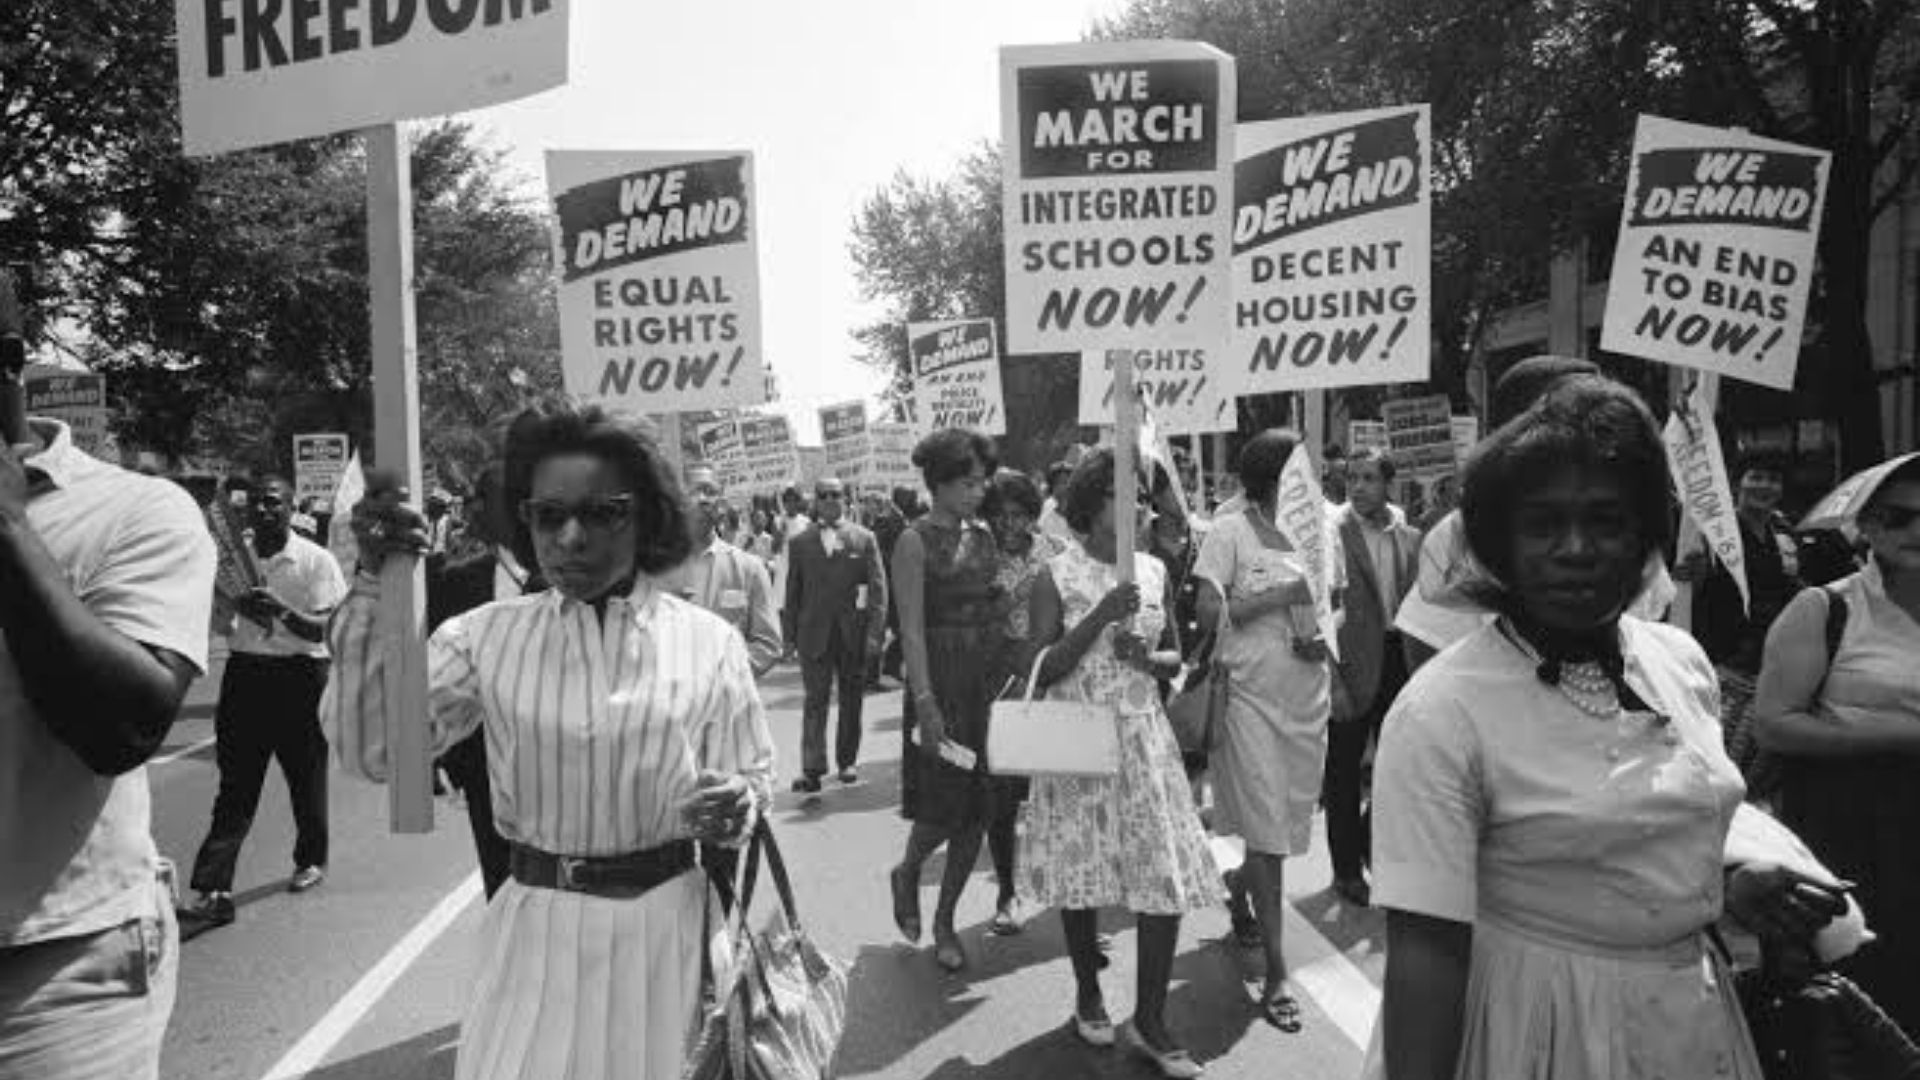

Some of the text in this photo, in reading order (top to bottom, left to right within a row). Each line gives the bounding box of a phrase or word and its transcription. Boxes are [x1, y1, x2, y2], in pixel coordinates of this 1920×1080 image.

[204, 0, 552, 78] FREED
[1089, 69, 1150, 101] WE
[1034, 104, 1204, 147] MARCH
[1087, 149, 1154, 170] FOR
[1282, 131, 1356, 187] WE
[1694, 152, 1766, 184] WE
[619, 170, 687, 216] WE
[1021, 185, 1218, 225] INTEGRATED
[1233, 155, 1415, 245] DEMAND
[1642, 184, 1811, 220] DEMAND
[574, 196, 742, 269] DEMAND
[1022, 233, 1215, 272] SCHOOLS
[1251, 241, 1403, 284] DECENT
[1642, 234, 1799, 287] AN END
[594, 275, 732, 309] EQUAL
[1037, 275, 1207, 332] NOW!
[1236, 284, 1417, 329] HOUSING
[1641, 267, 1789, 322] TO BIAS
[594, 313, 738, 347] RIGHTS
[1249, 315, 1409, 374] NOW!
[1634, 305, 1784, 362] NOW!
[599, 345, 744, 396] NOW!
[920, 337, 989, 373] DEMAND
[1104, 349, 1206, 371] RGHTS
